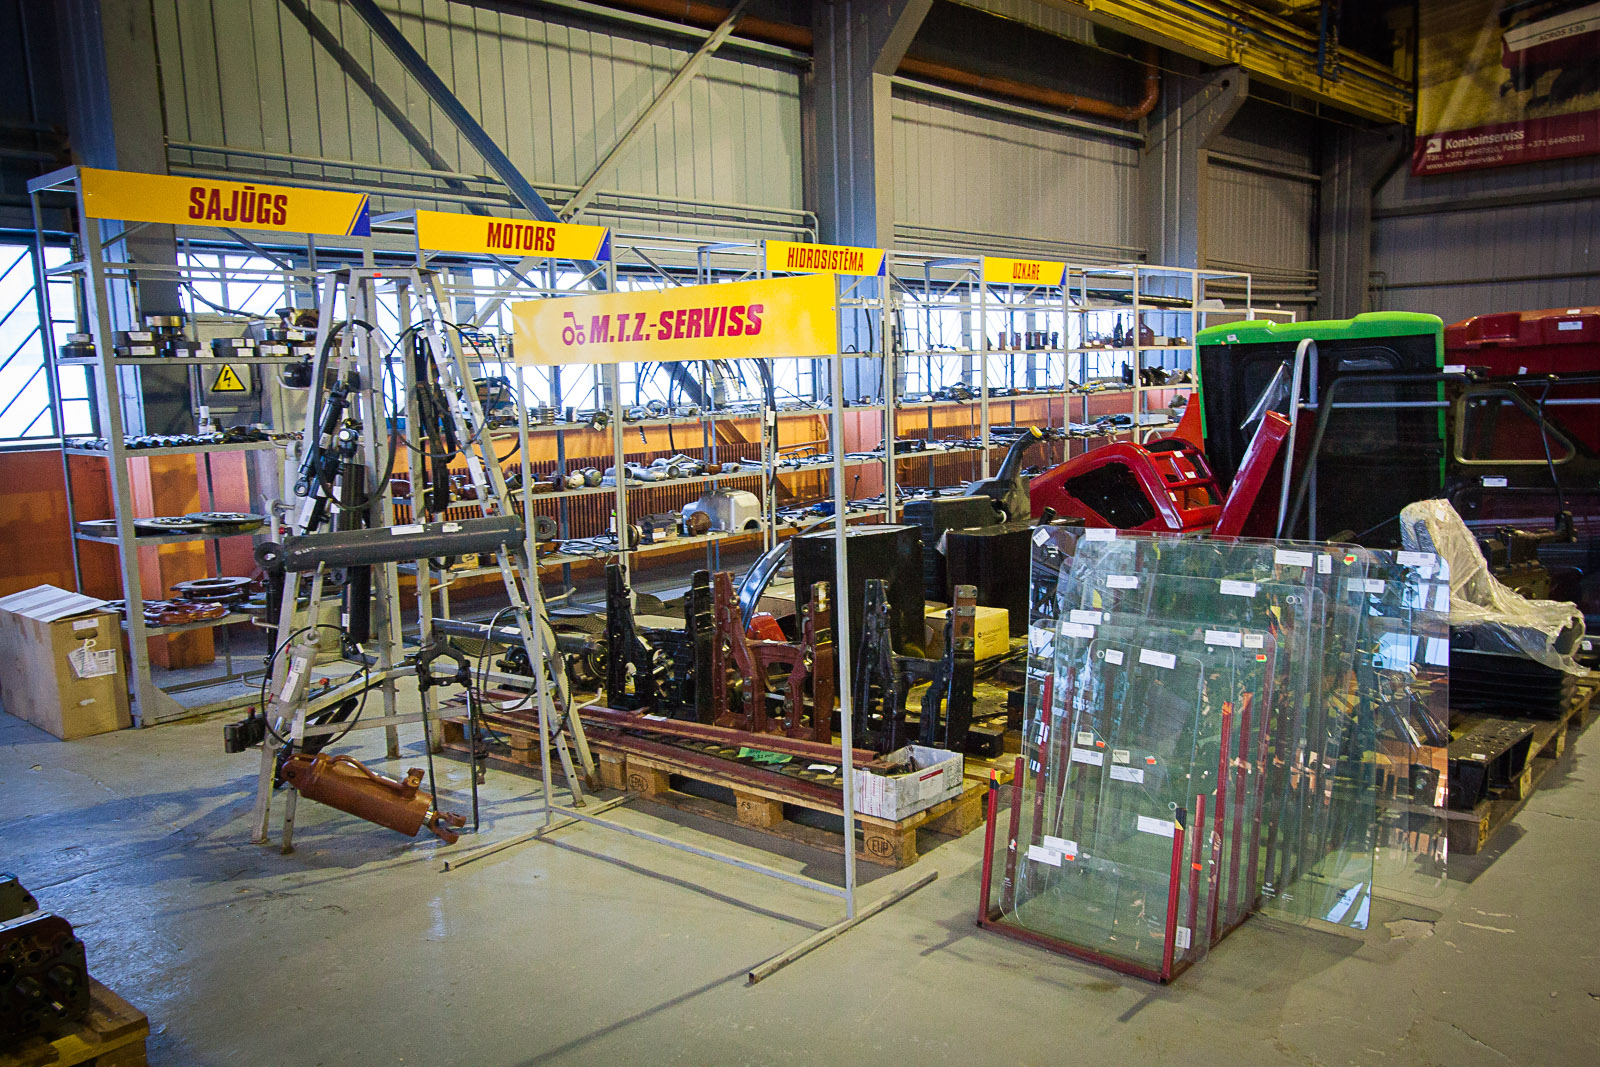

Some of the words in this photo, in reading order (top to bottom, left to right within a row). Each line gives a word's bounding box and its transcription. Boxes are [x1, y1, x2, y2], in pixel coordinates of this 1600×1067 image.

[1445, 130, 1525, 149] Kombainserviss
[189, 185, 288, 226] SAJŪGS
[486, 222, 556, 252] MOTORS
[787, 247, 864, 272] HIDROSISTĒMA
[590, 303, 764, 344] M.T.Z.-SERVISS
